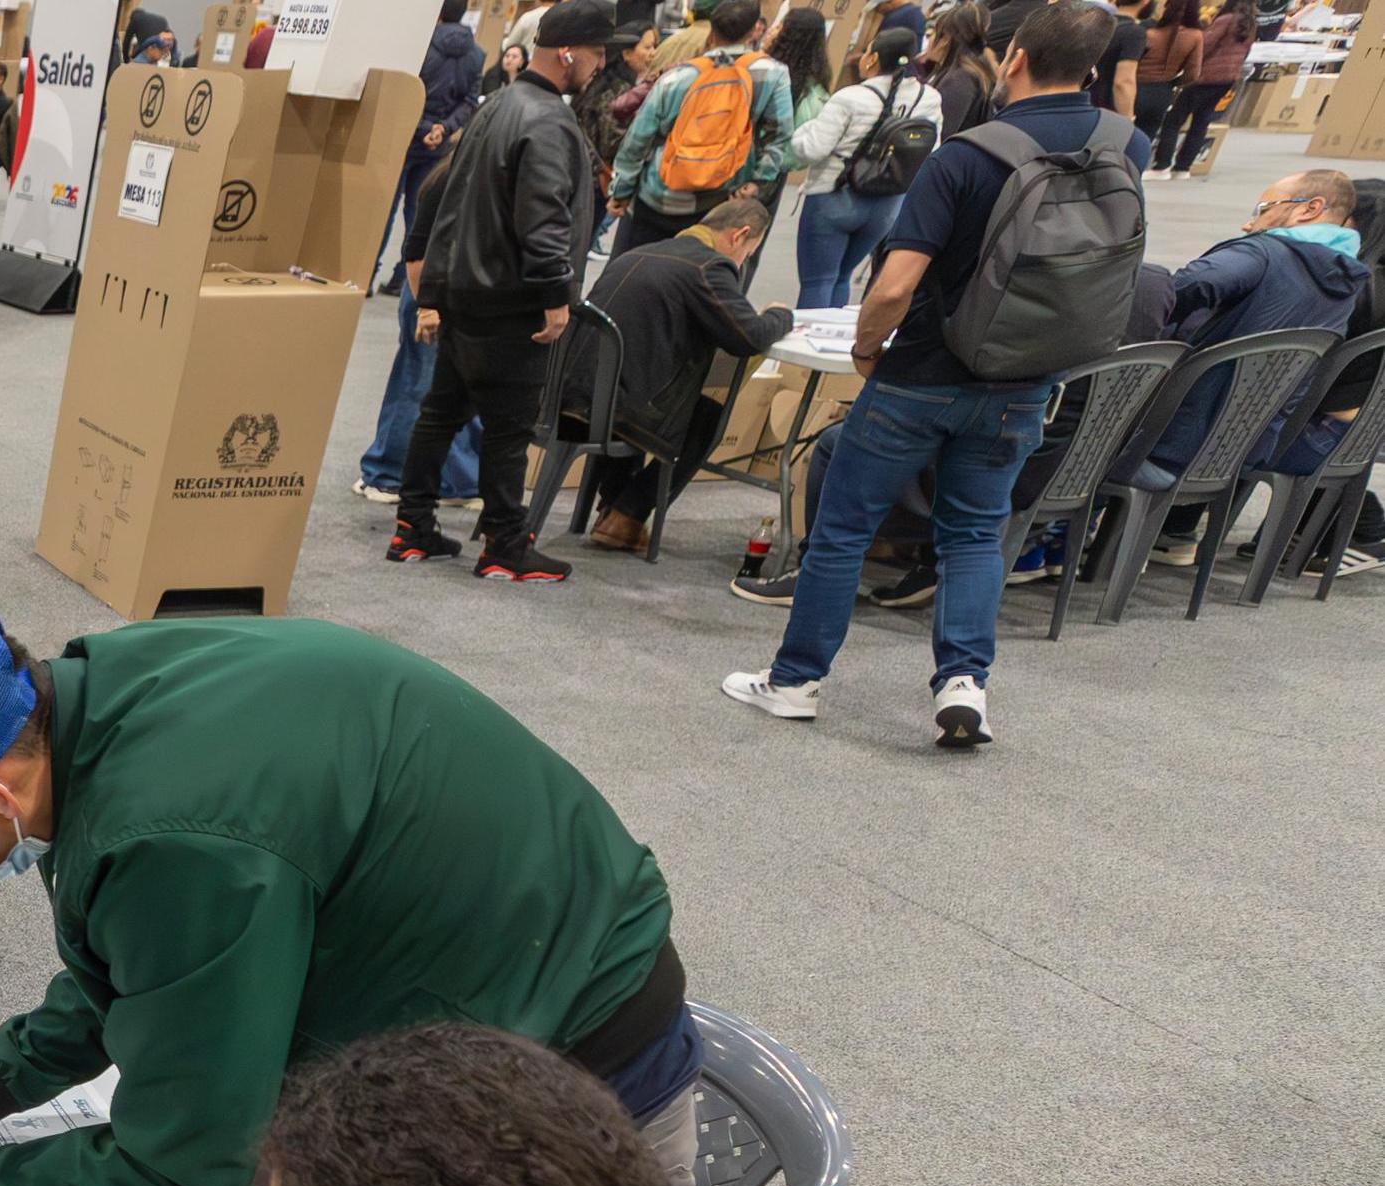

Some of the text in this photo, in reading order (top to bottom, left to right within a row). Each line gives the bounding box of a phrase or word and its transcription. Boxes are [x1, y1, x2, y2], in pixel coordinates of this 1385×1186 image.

[37, 50, 94, 88] Salida
[124, 183, 162, 208] MESA 113
[174, 472, 305, 490] REGISTRADURÍA
[172, 488, 303, 499] NACIONAL DEL ESTADO CIVIL
